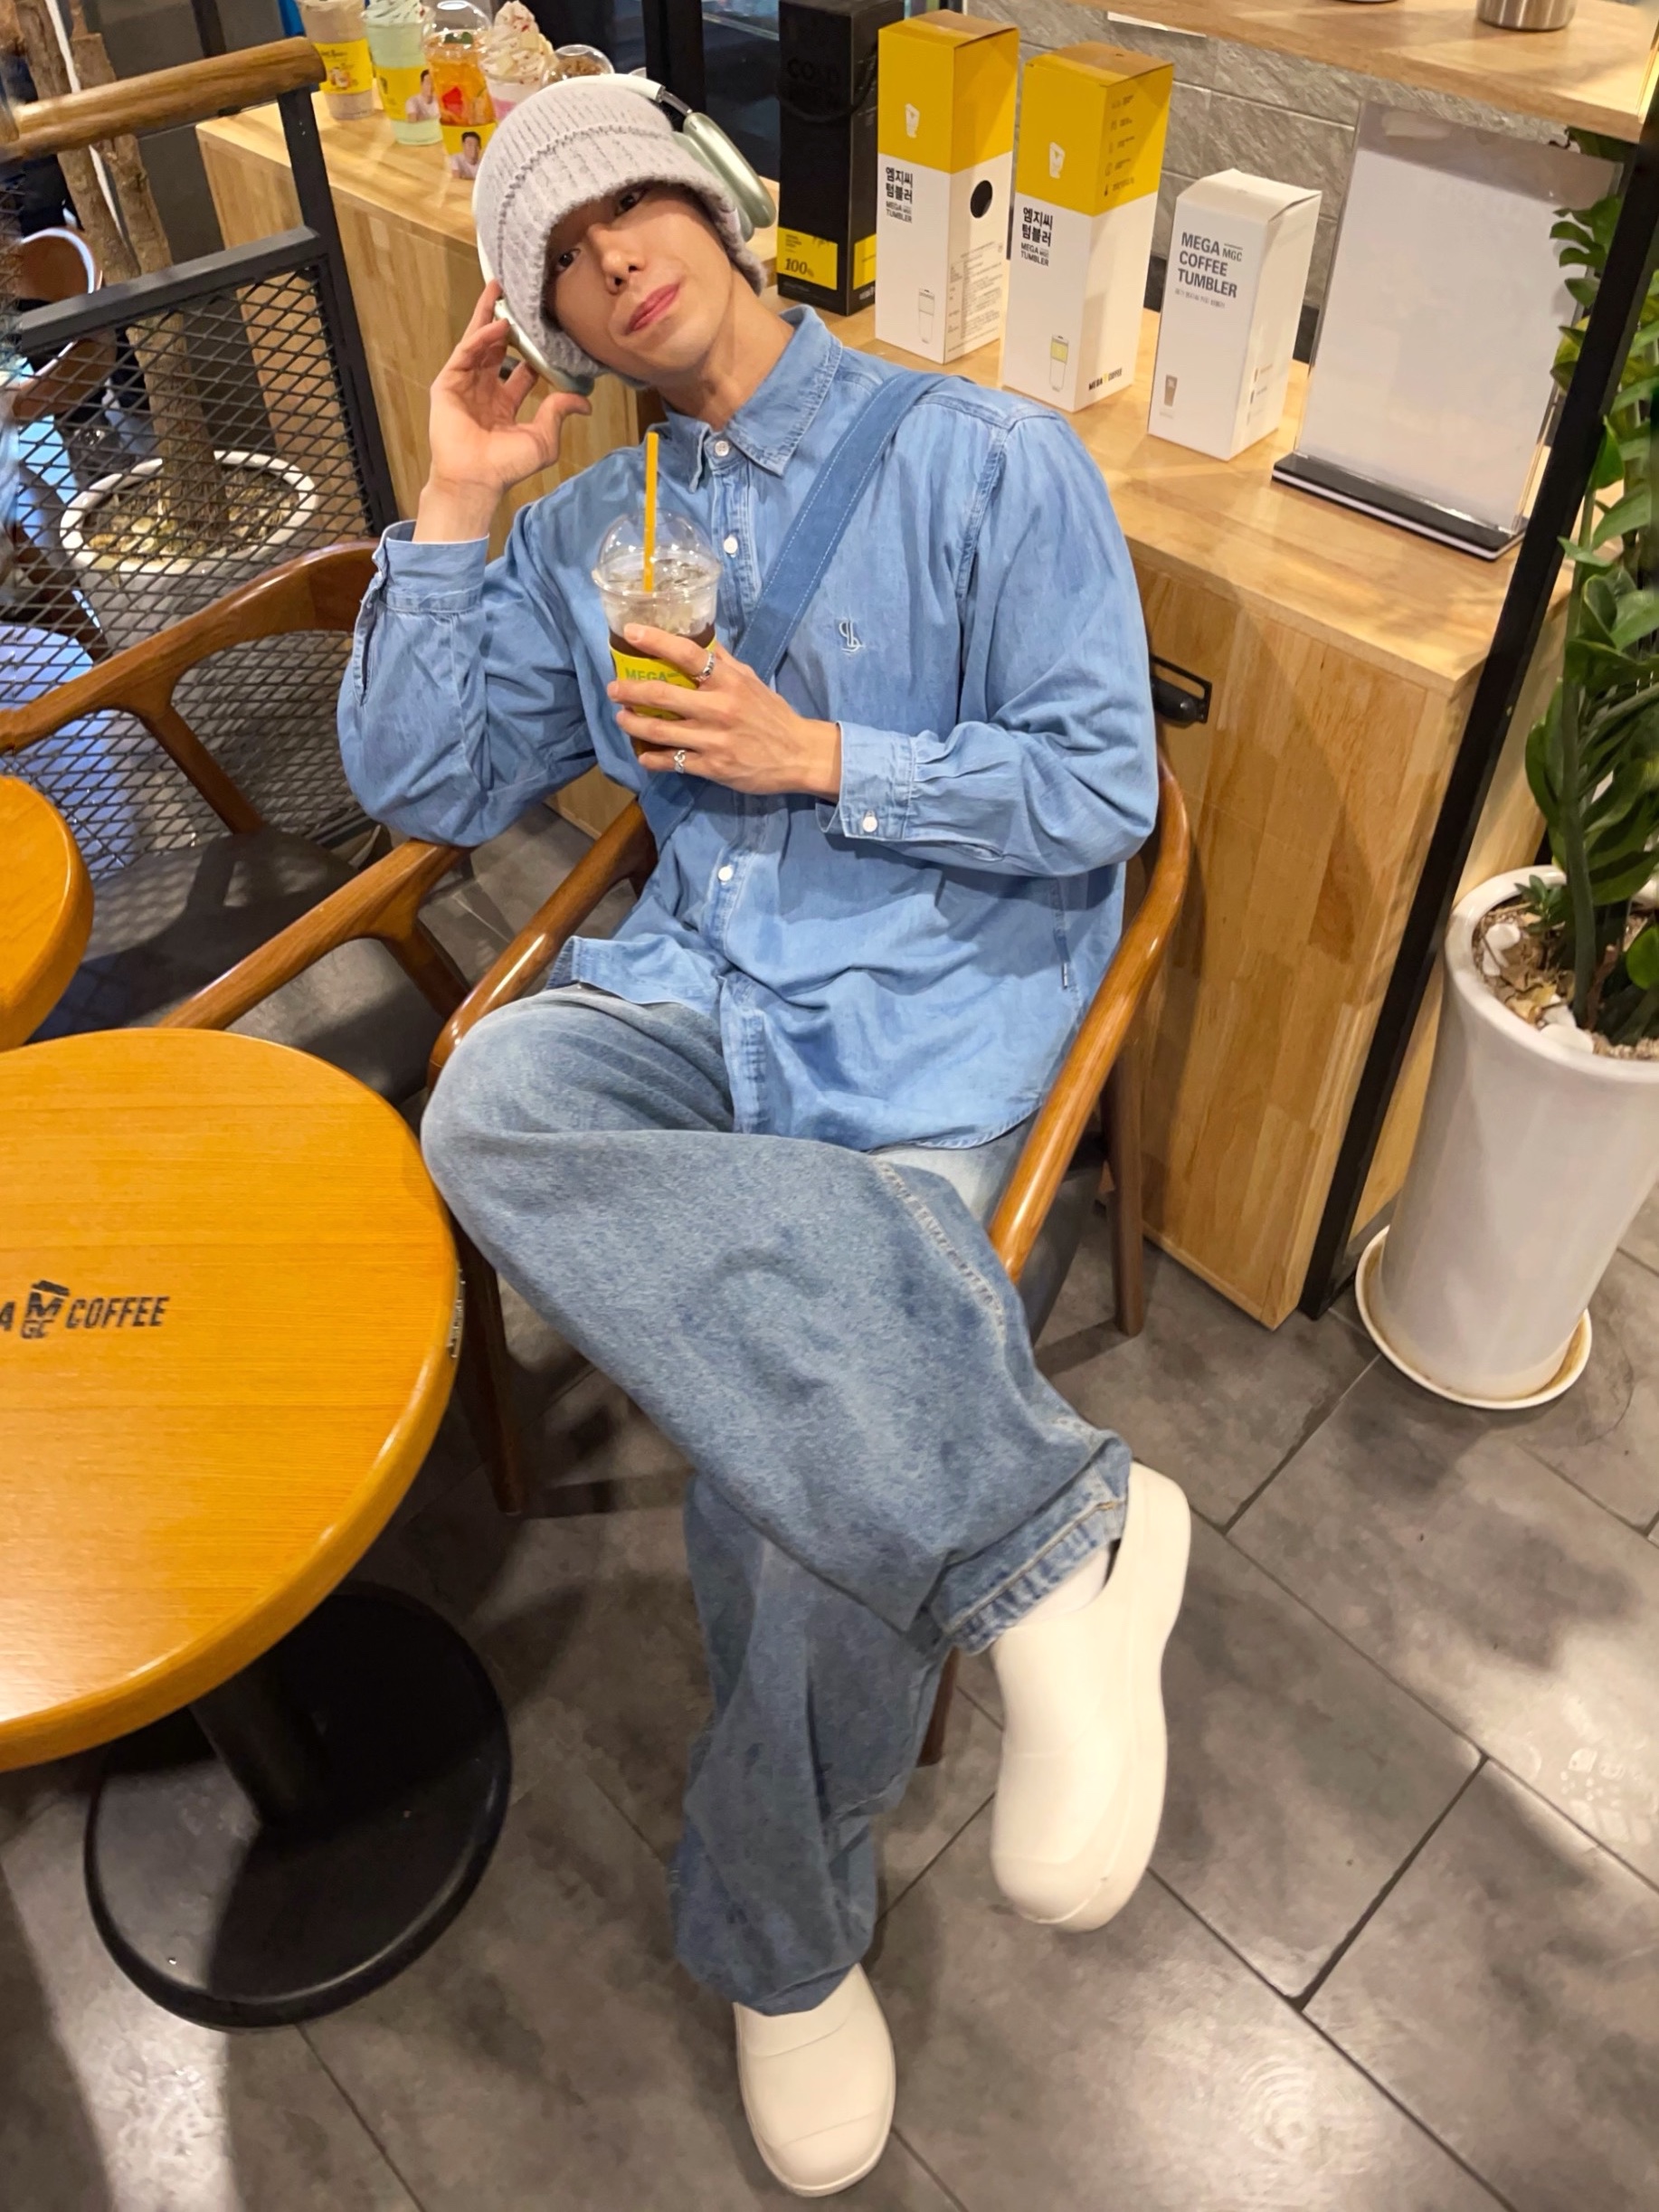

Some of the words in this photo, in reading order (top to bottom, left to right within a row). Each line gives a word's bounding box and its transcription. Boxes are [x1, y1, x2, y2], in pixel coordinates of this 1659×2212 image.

[886, 166, 913, 188] 엠지씨
[886, 208, 913, 223] TUMBLER
[1023, 206, 1053, 231] 엠지씨
[1020, 242, 1039, 254] MEGA
[1180, 232, 1220, 256] MEGA
[1222, 247, 1243, 262] MGC
[1020, 251, 1049, 267] TUMBLER
[1179, 250, 1228, 277] COFFEE
[1178, 268, 1237, 299] TUMBLER
[625, 668, 667, 681] MEGA
[65, 1296, 170, 1329] COFFEE
